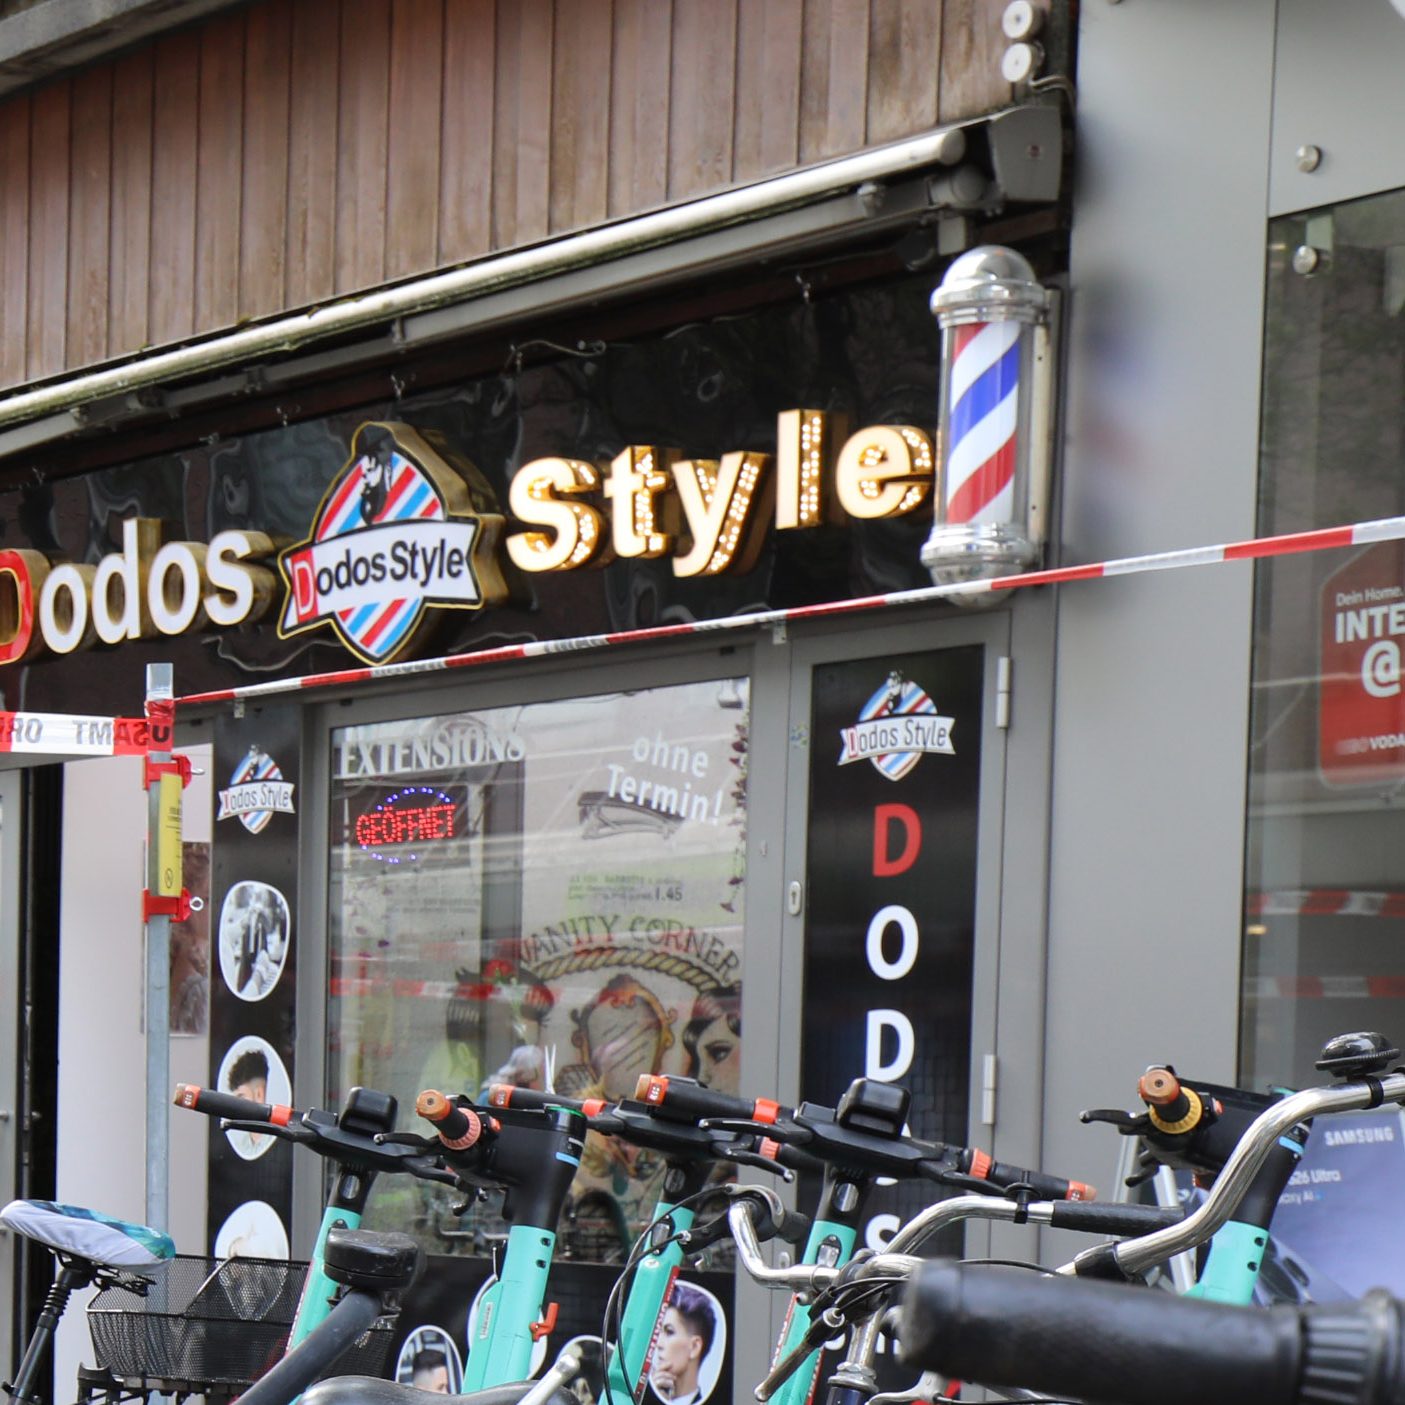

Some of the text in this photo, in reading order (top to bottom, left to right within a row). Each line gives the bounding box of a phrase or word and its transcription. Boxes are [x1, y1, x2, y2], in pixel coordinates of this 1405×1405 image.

[506, 408, 935, 577] Style
[1336, 592, 1363, 608] Dein
[1335, 602, 1405, 644] INTE
[1361, 640, 1402, 698] @
[341, 728, 526, 778] EXTENSIONS
[633, 732, 709, 780] ohne
[847, 719, 948, 759] Dodos Style
[1369, 734, 1405, 751] VODA
[260, 785, 290, 811] Style
[606, 763, 724, 828] Termin!
[355, 804, 457, 846] GEÖFFNET
[629, 915, 740, 983] CORNER
[1324, 1126, 1395, 1147] SAMSUNG
